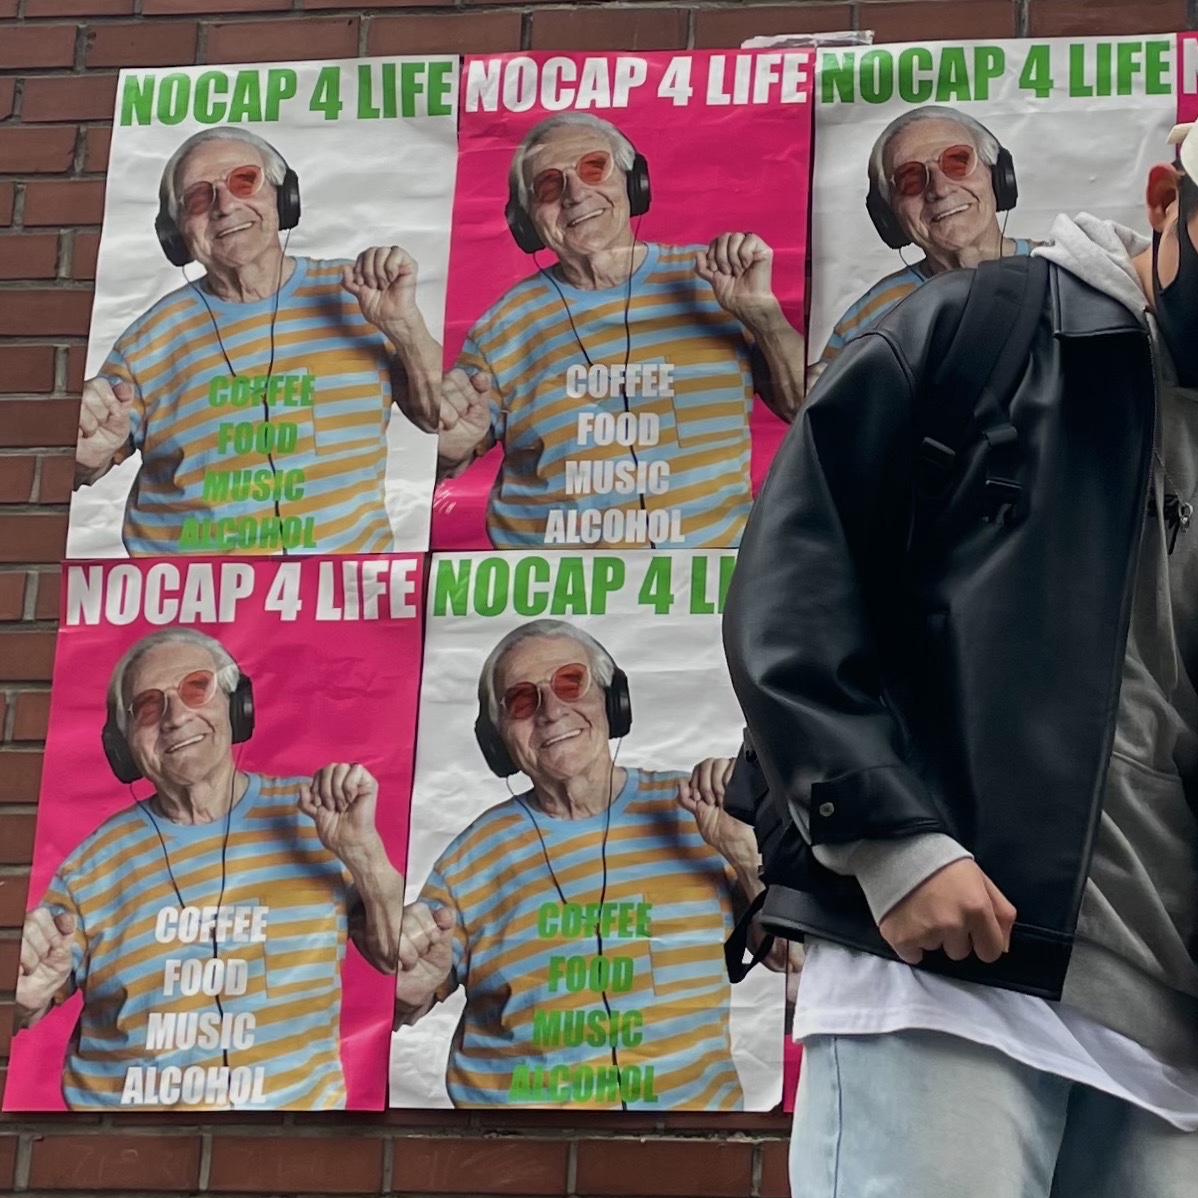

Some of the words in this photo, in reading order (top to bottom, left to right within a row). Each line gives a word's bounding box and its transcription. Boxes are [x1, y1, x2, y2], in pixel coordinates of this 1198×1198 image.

[464, 56, 648, 113] NOCAP
[656, 56, 693, 105] 4
[707, 53, 808, 104] LIFE
[821, 46, 1006, 104] NOCAP
[1019, 45, 1054, 98] 4
[1070, 41, 1171, 98] LIFE
[120, 67, 298, 126] NOCAP
[309, 66, 343, 120] 4
[353, 61, 452, 118] LIFE
[208, 374, 315, 408] COFFEE
[566, 364, 675, 399] COFFEE
[217, 422, 298, 455] FOOD
[577, 412, 659, 446] FOOD
[202, 469, 305, 502] MUSIC
[565, 461, 670, 495] MUSIC
[179, 516, 317, 550] ALCOHOL
[544, 508, 686, 544] ALCOHOL
[66, 564, 258, 626] NOCAP
[263, 563, 302, 622] 4
[315, 560, 417, 621] LIFE
[433, 556, 625, 616] NOCAP
[638, 556, 674, 614] 4
[689, 555, 736, 614] LI
[154, 906, 268, 943] COFFEE
[537, 901, 652, 940] COFFEE
[163, 958, 248, 996] FOOD
[547, 956, 633, 993] FOOD
[145, 1013, 256, 1050] MUSIC
[532, 1010, 643, 1048] MUSIC
[121, 1066, 267, 1105] ALCOHOL
[506, 1066, 659, 1104] ALCOHOL
